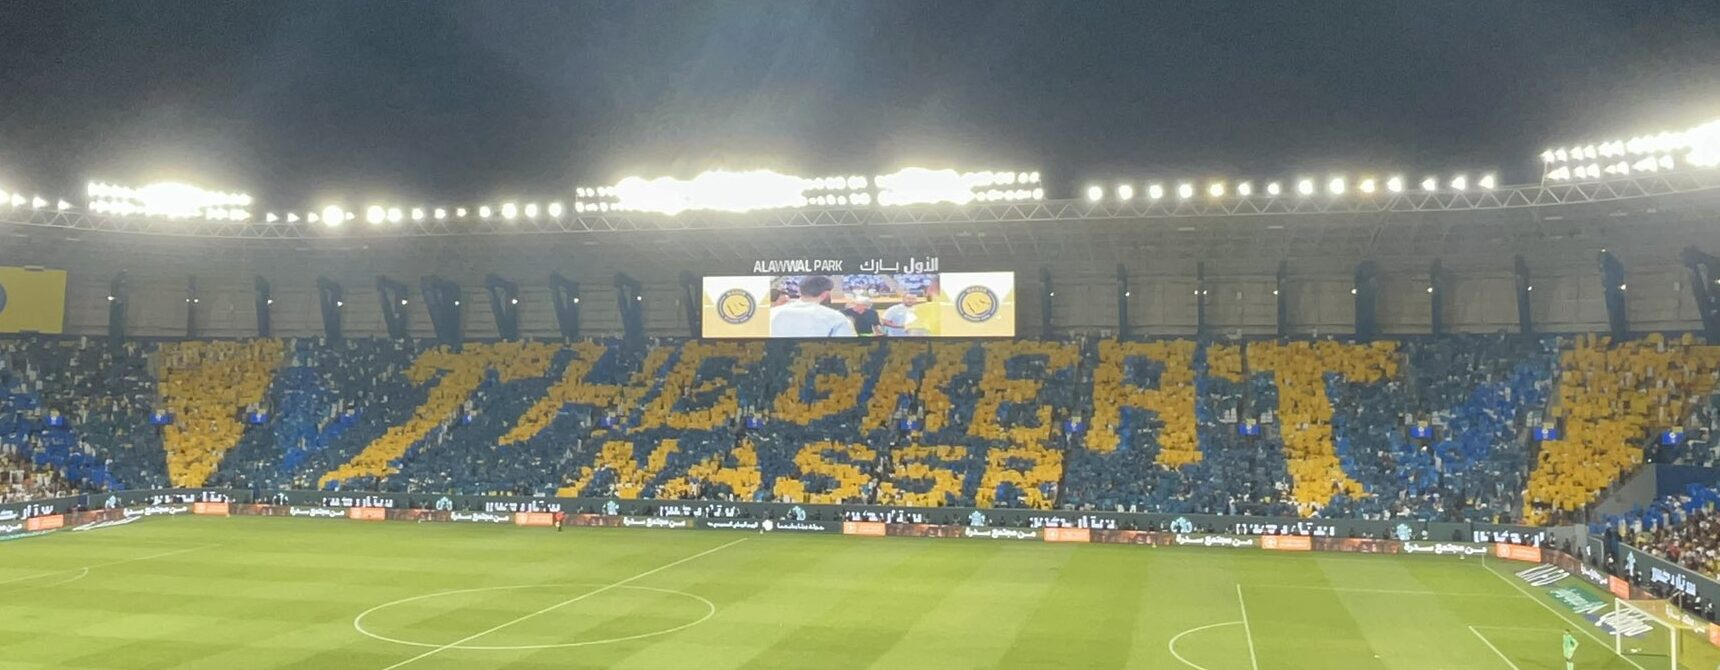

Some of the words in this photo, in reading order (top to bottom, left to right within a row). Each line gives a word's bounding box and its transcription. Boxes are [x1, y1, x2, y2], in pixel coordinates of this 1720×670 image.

[753, 259, 812, 273] ALAWWAL
[813, 259, 843, 272] PARK
[903, 256, 939, 274] الأول
[318, 341, 767, 490] THE
[773, 338, 1401, 519] GREAT
[557, 438, 1063, 508] NASSR
